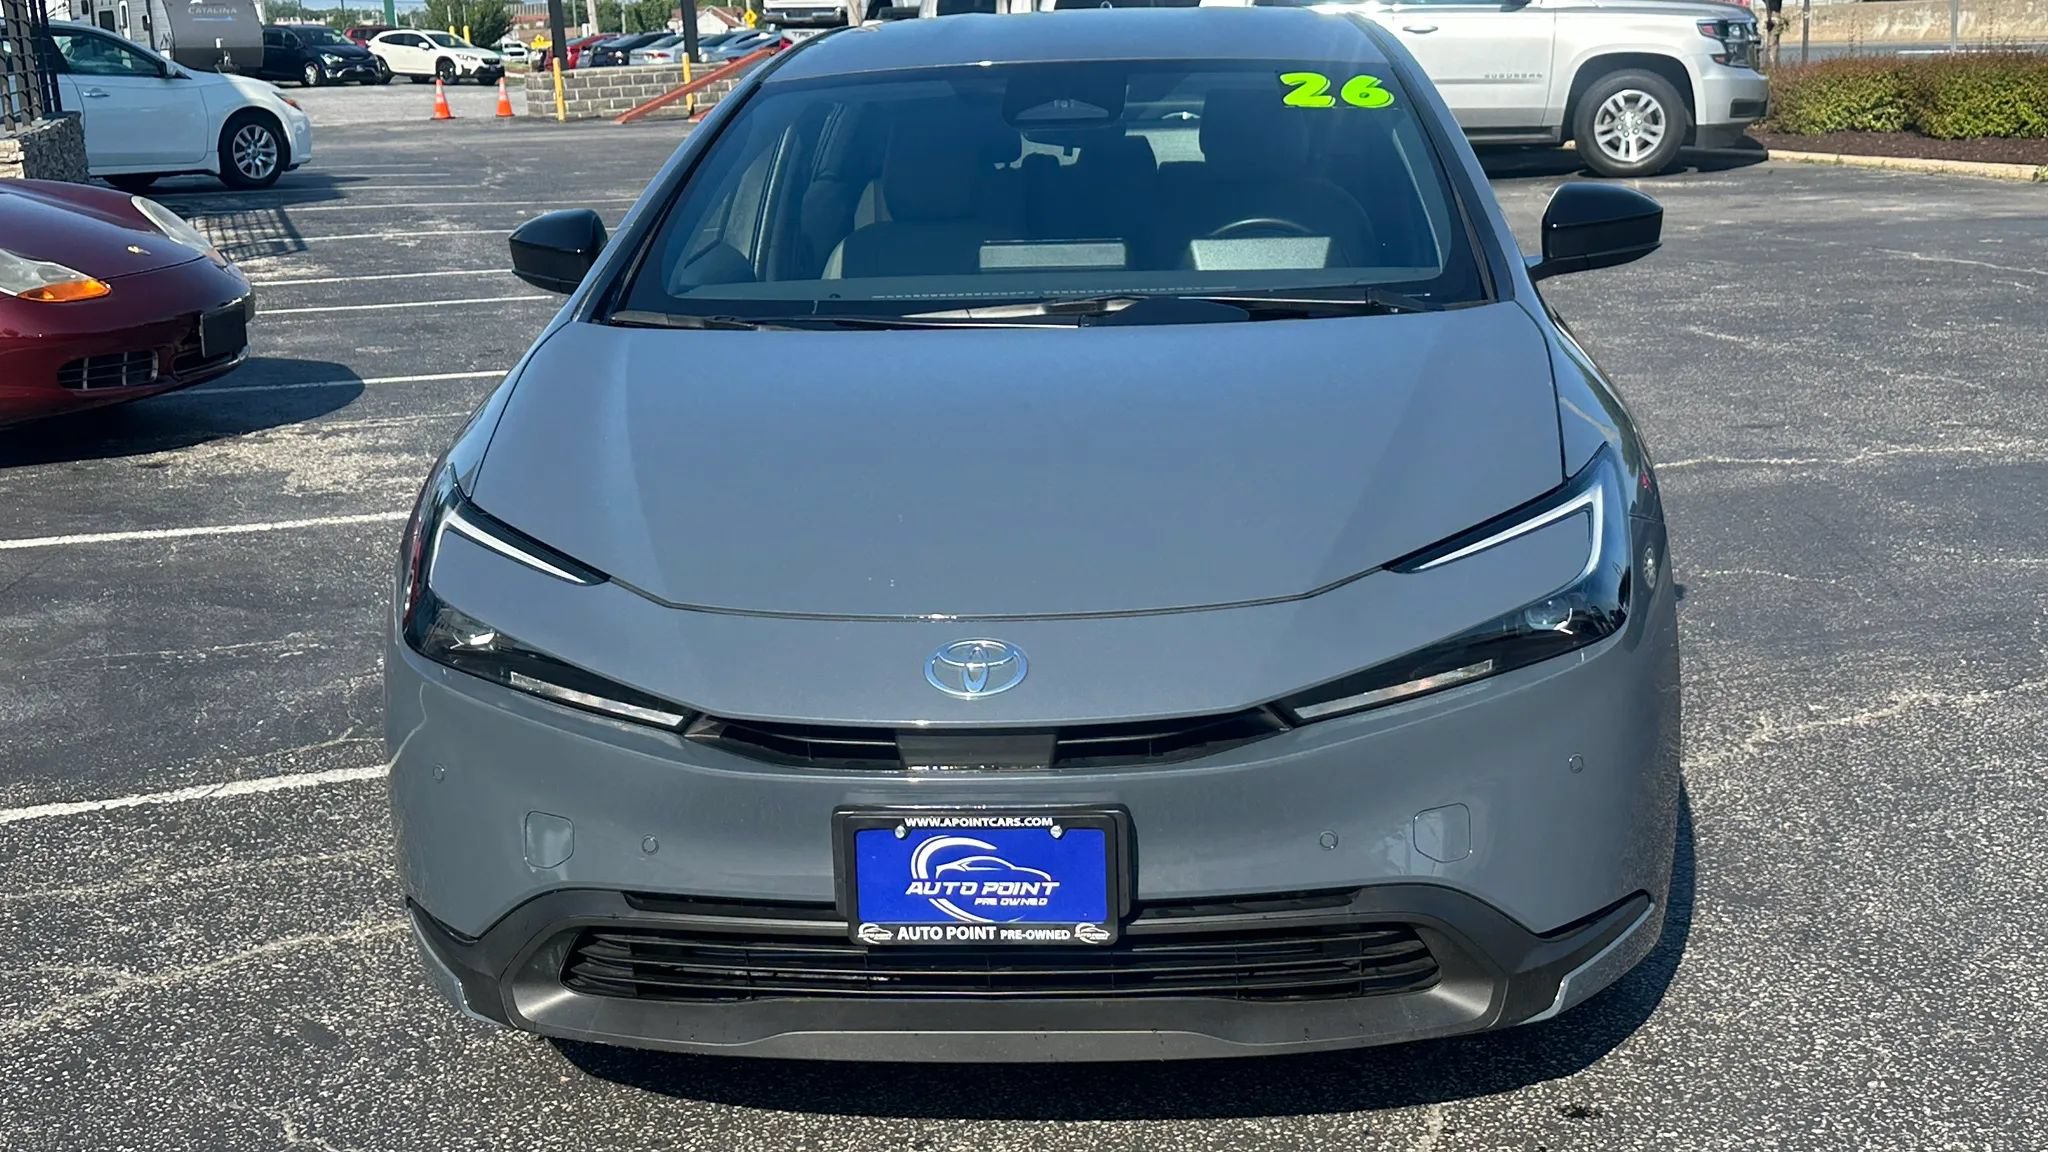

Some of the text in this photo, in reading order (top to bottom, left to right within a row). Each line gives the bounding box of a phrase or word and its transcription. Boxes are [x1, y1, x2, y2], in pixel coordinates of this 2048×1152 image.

[187, 7, 238, 15] CATALINA
[1280, 72, 1395, 108] 26
[904, 817, 1054, 828] WWW.APOINTCARS.COM
[905, 881, 1060, 895] AUTO POINT
[974, 897, 1048, 906] PRE OWNED
[897, 926, 944, 940] AUTO
[946, 926, 997, 940] POINT
[1000, 929, 1070, 940] PRE-OWNED
